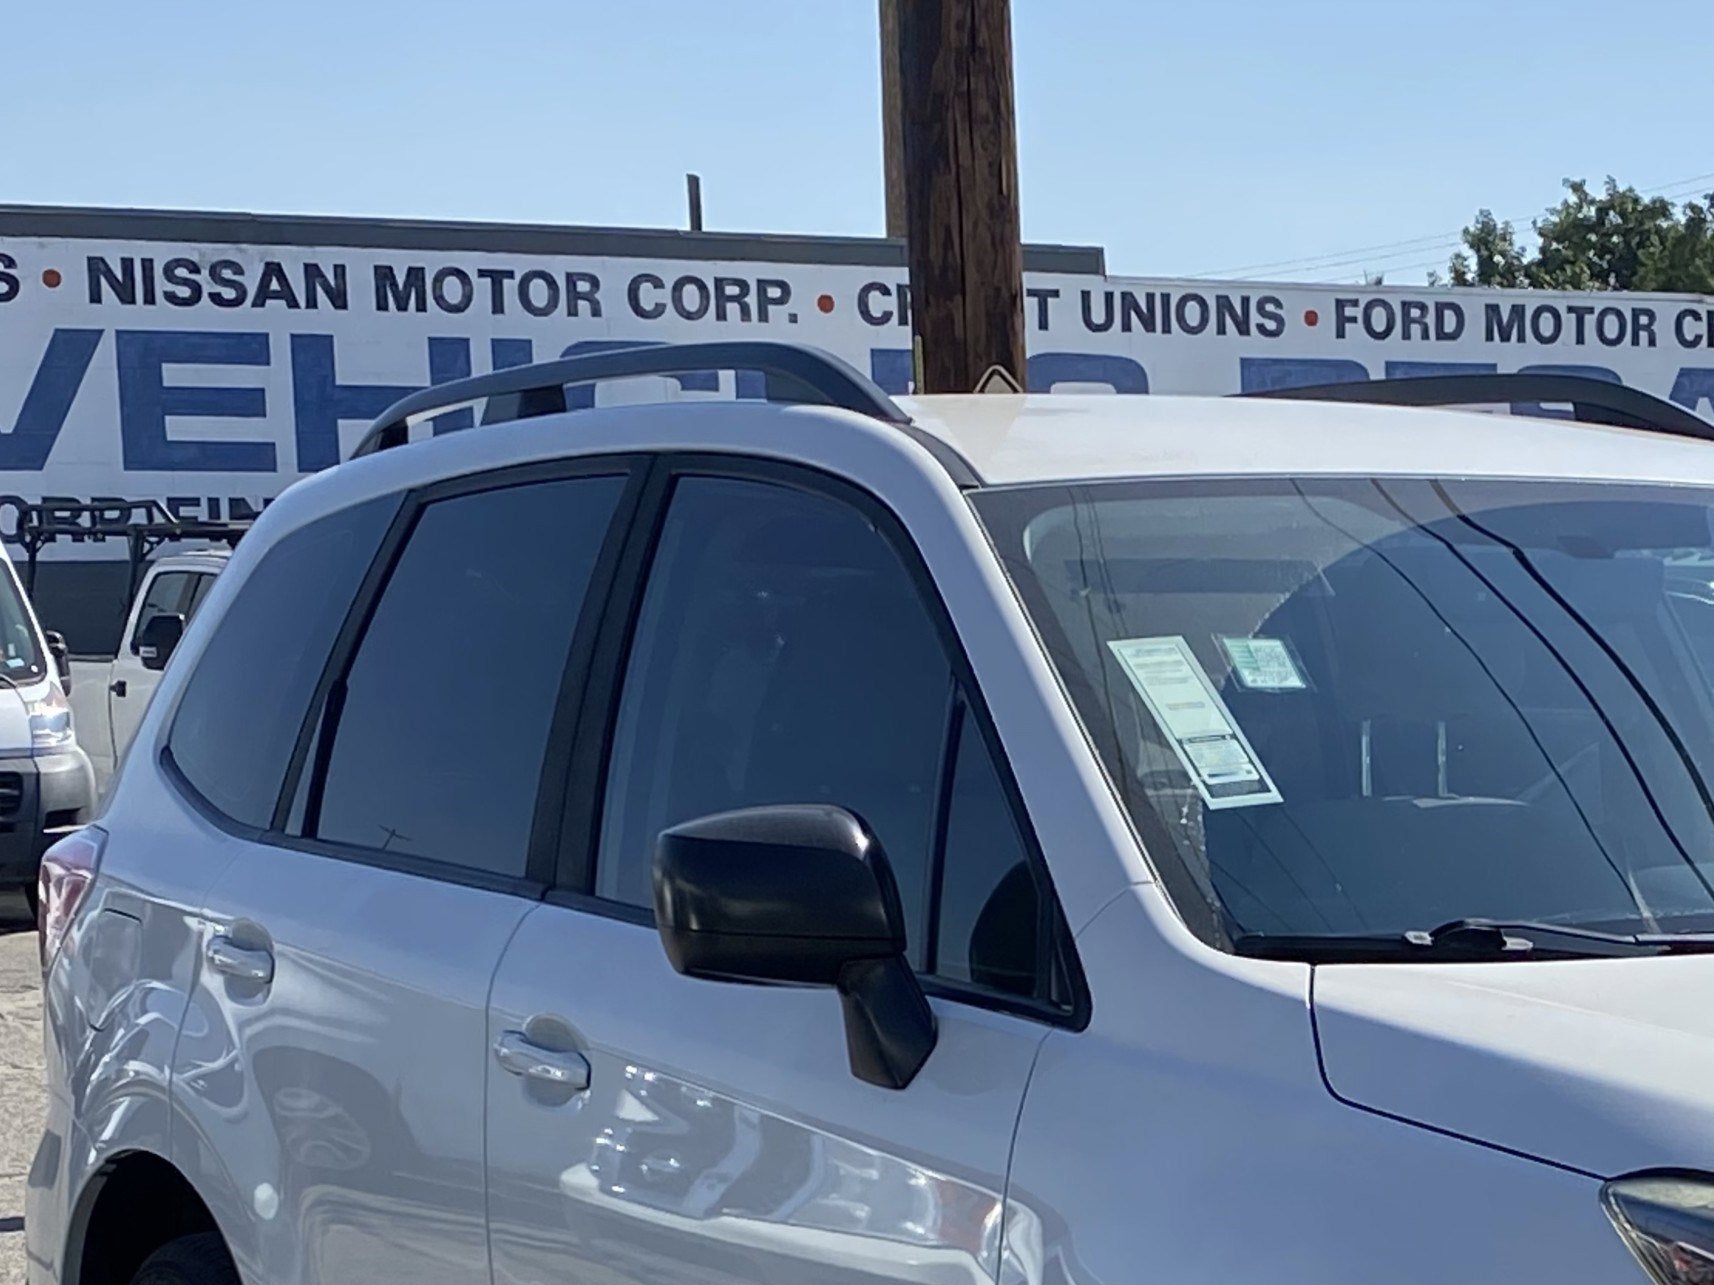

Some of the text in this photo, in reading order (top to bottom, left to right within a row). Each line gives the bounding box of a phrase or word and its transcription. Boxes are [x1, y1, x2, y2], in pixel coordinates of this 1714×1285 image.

[87, 255, 346, 312] NISSAN
[374, 264, 602, 318] MOTOR
[626, 271, 799, 325] CORP.
[1080, 289, 1286, 338] UNIONS
[1334, 297, 1466, 342] FORD
[1484, 302, 1657, 349] MOTOR
